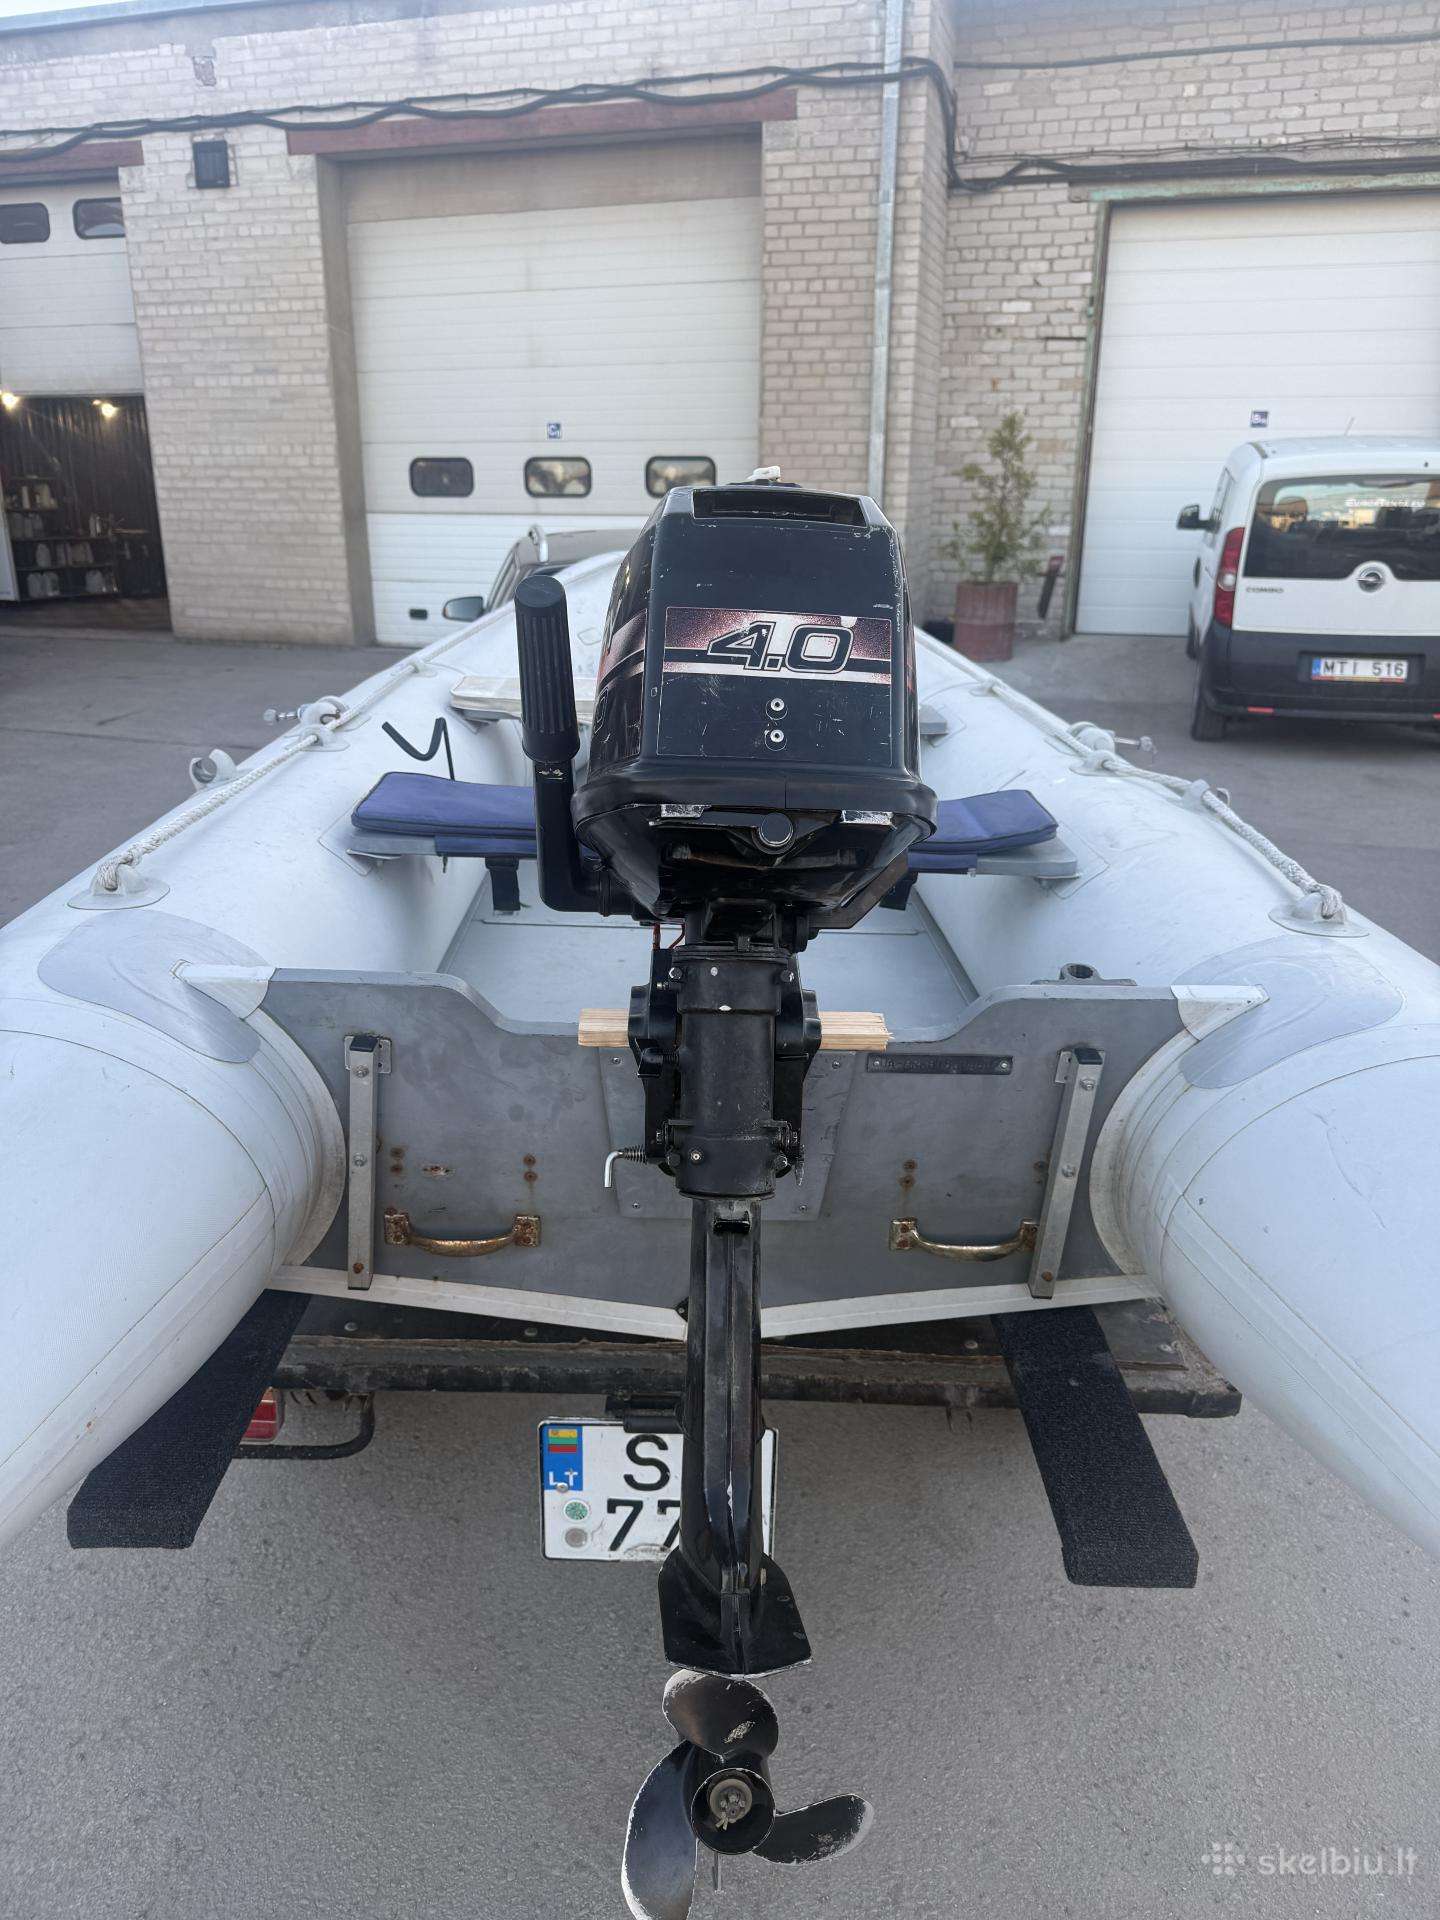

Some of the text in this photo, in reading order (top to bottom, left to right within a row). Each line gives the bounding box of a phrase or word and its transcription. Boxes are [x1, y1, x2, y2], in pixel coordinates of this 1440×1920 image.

[706, 620, 855, 675] 4.0
[1323, 660, 1404, 676] MTI 516
[548, 1469, 578, 1487] LT
[623, 1433, 671, 1491] S
[606, 1498, 681, 1552] 77
